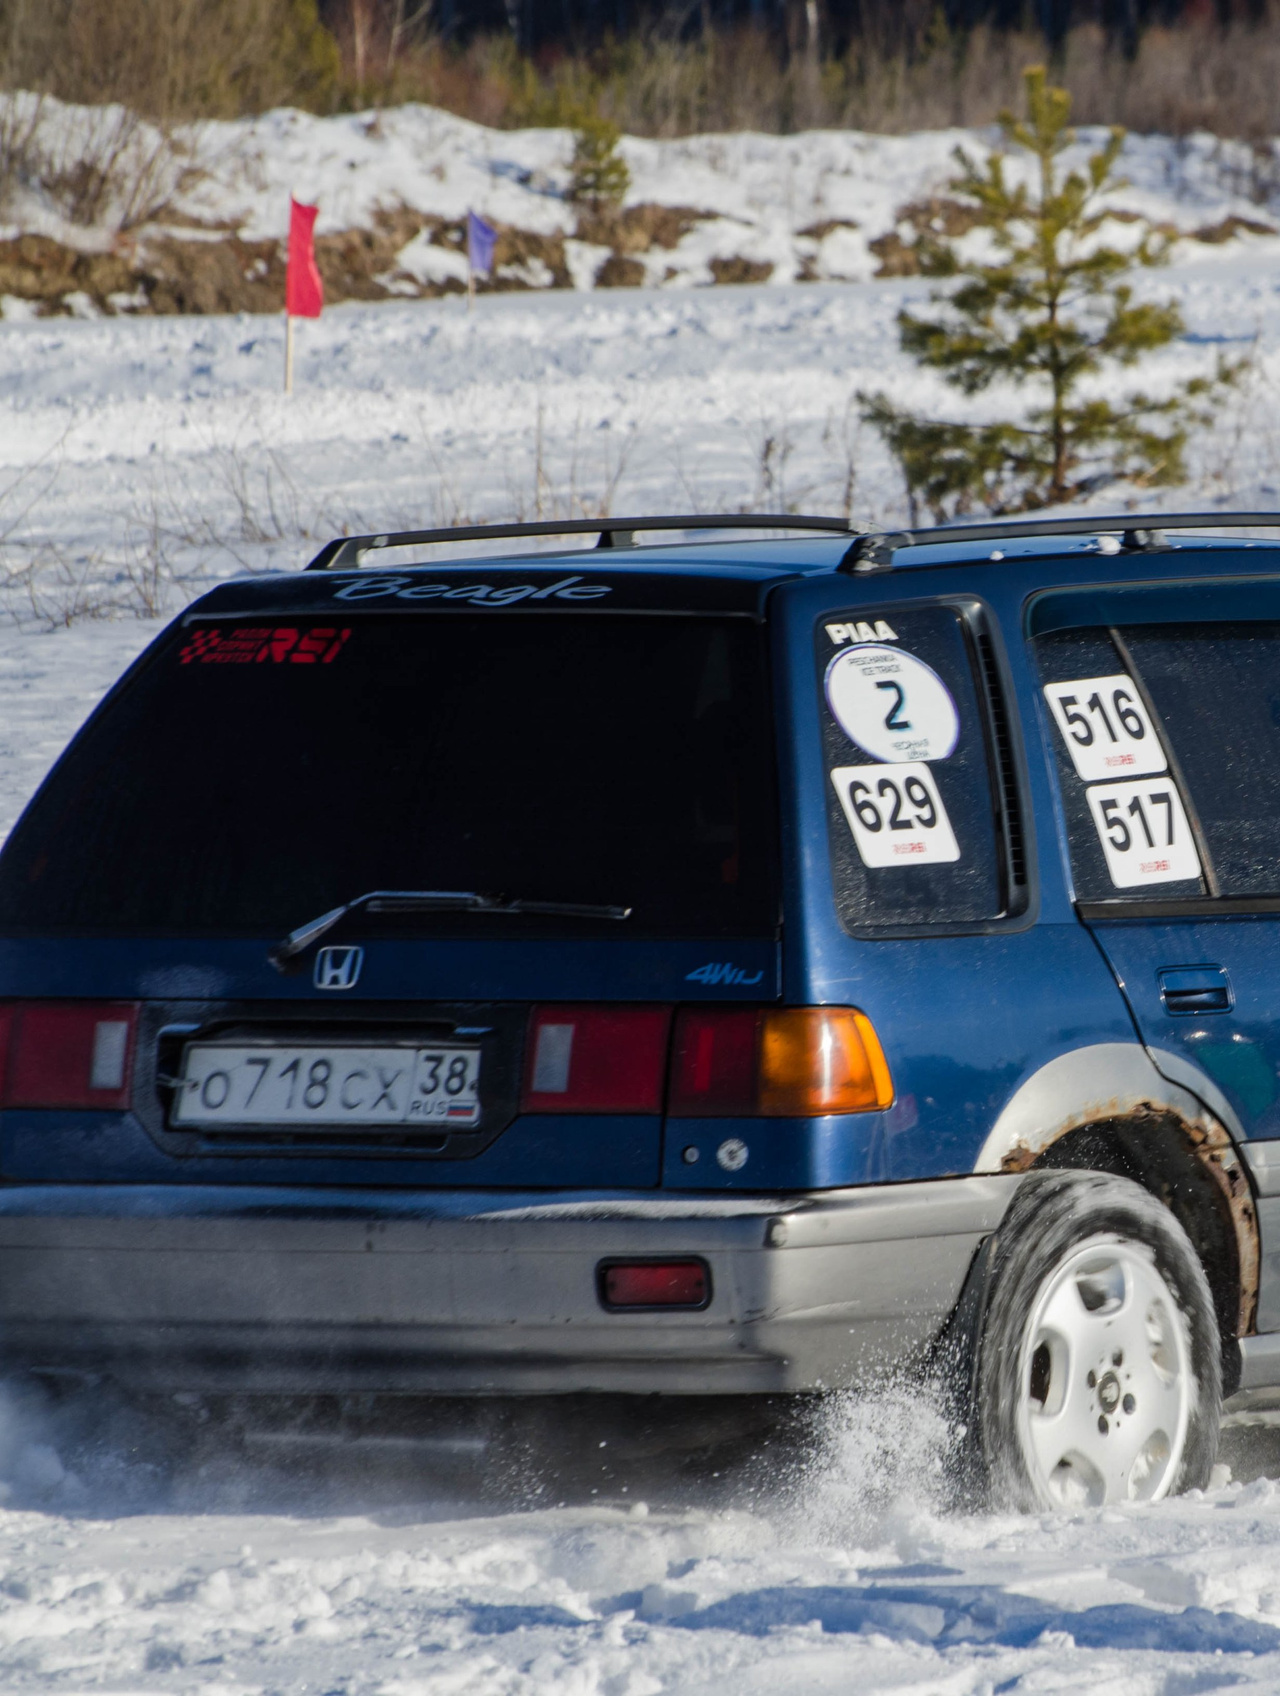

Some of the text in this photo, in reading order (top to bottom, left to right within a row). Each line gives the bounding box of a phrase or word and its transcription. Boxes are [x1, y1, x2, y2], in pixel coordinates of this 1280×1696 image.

[331, 576, 613, 607] Beagle
[825, 621, 899, 644] PIAA
[875, 681, 910, 730] 2
[1058, 688, 1145, 747] 516
[848, 774, 937, 834] 629
[1098, 791, 1174, 853] 517
[418, 1054, 470, 1097] 38
[409, 1099, 447, 1117] RUS
